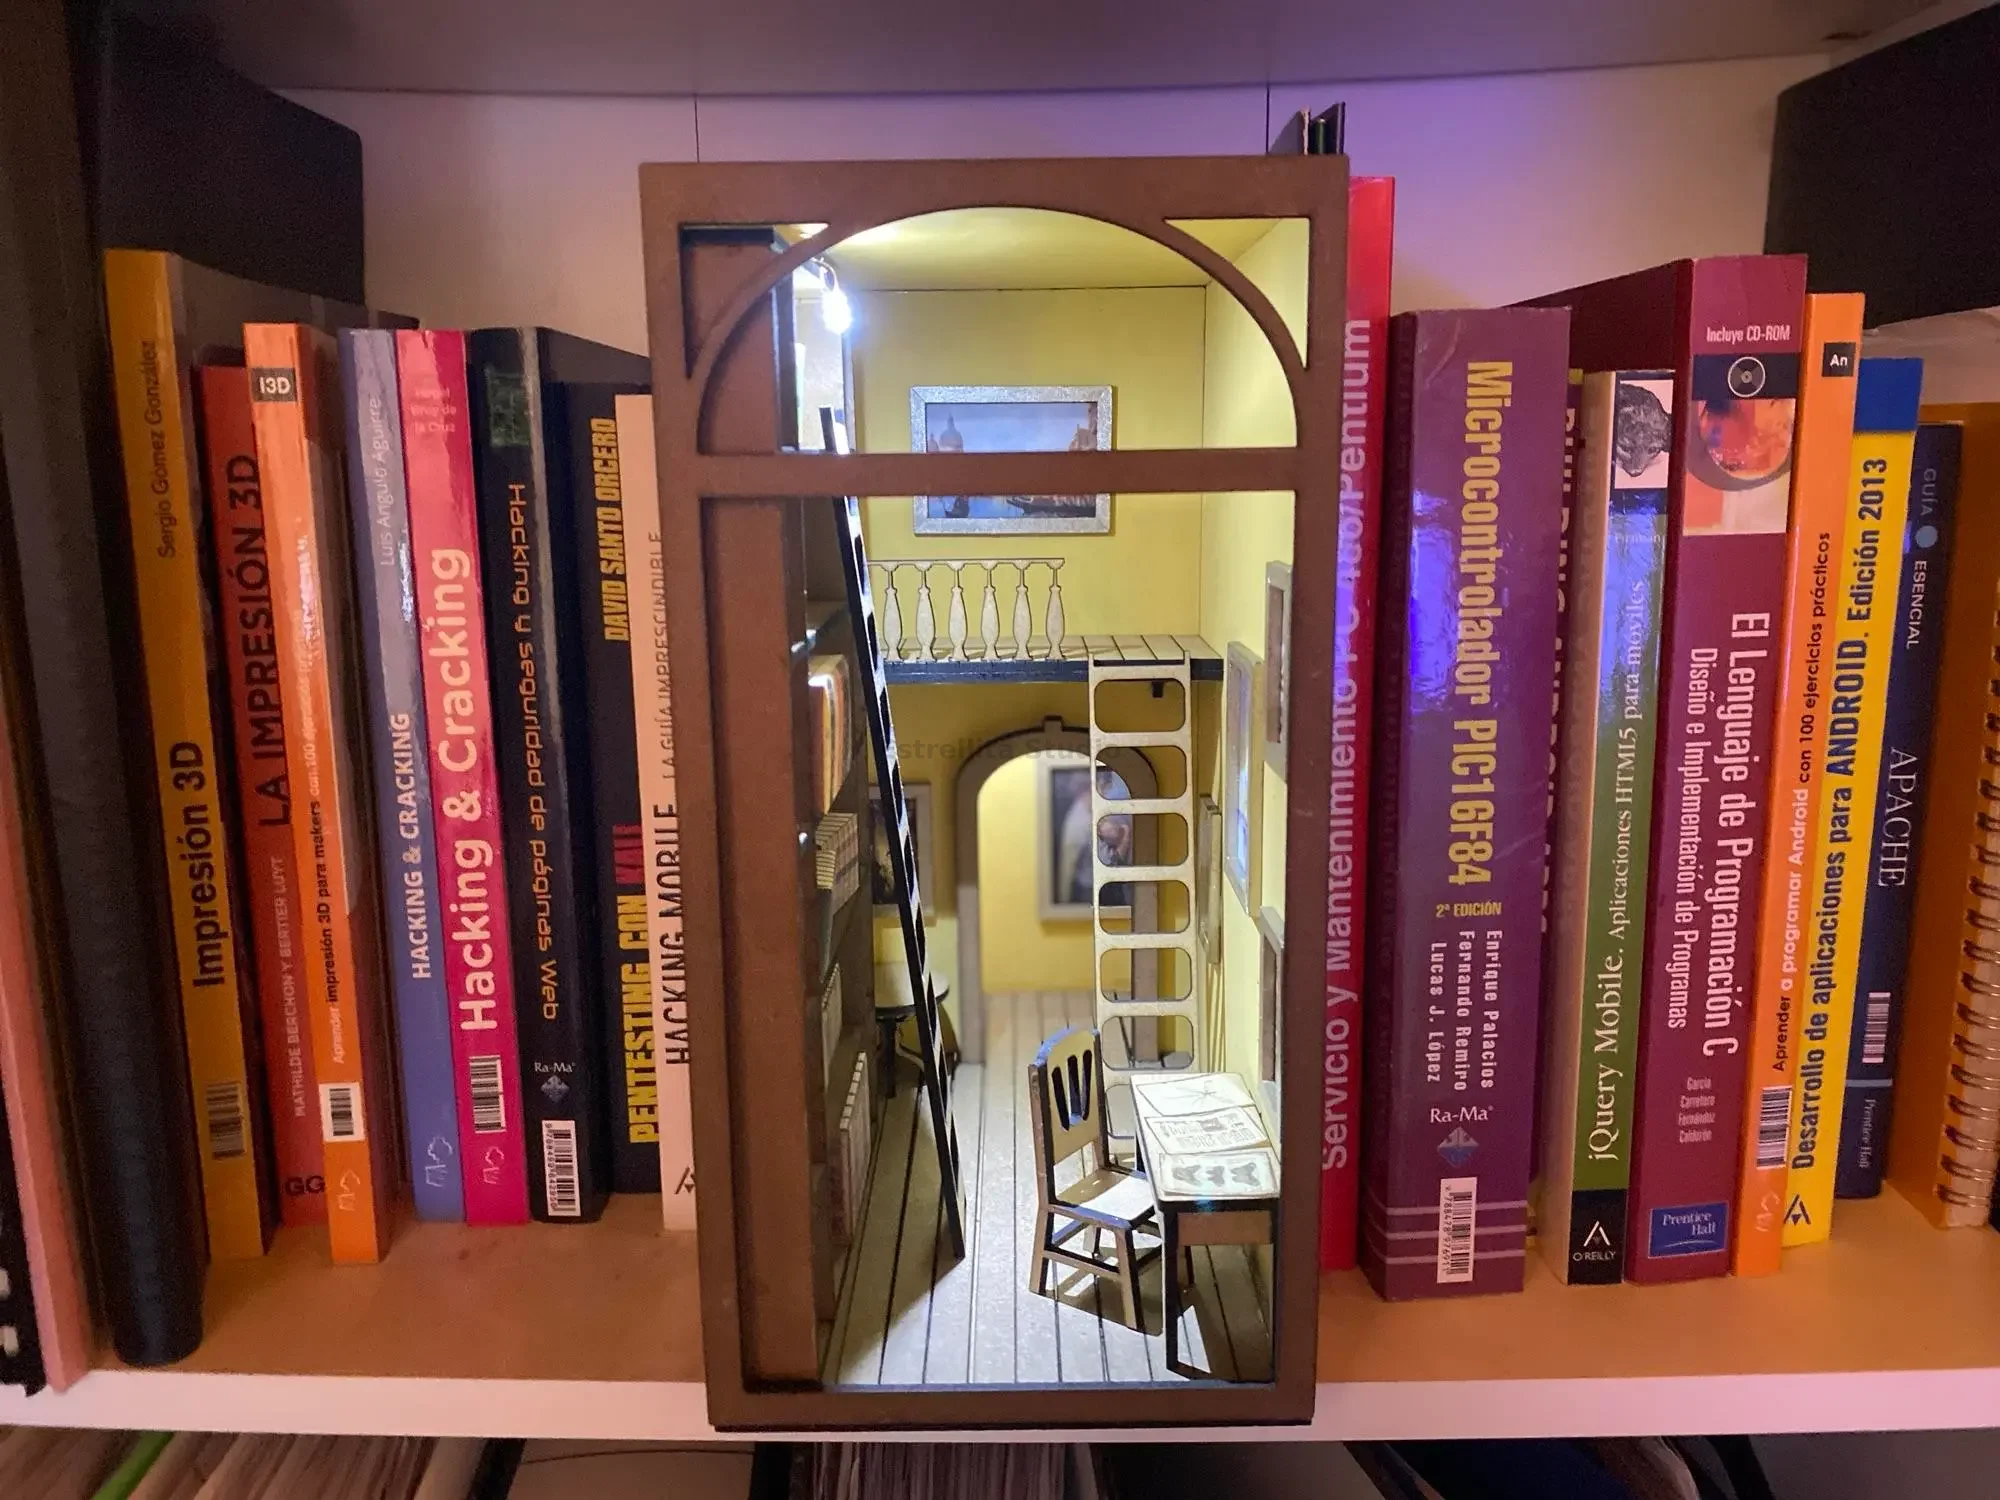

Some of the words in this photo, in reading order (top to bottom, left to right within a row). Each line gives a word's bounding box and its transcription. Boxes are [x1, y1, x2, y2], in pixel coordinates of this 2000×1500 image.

[1706, 328, 1744, 345] Incluye
[1746, 325, 1791, 342] CD-ROM
[1829, 353, 1848, 368] An
[259, 377, 290, 394] I3D
[368, 397, 390, 465] Aguirre
[591, 418, 620, 500] ORCERO
[226, 456, 258, 509] 3D
[378, 467, 396, 529] Angulo
[1858, 459, 1887, 521] 2013
[1920, 468, 1936, 516] GUÍA
[158, 497, 179, 560] Sergio
[381, 531, 394, 566] Luis
[508, 485, 531, 605] Hacking
[600, 507, 625, 575] SANTO
[1455, 361, 1514, 704] Microcontrolador
[1814, 532, 1831, 618] prácticos
[1847, 529, 1880, 622] Edición
[1906, 560, 1928, 650] ESENCIAL
[227, 527, 287, 757] IMPRESIÓN
[514, 614, 532, 632] y
[604, 580, 629, 642] DAVID
[1625, 581, 1645, 665] móviles
[1731, 612, 1770, 638] El
[426, 548, 478, 773] Cracking
[1686, 648, 1718, 717] Diseño
[1810, 625, 1824, 709] ejercicios
[518, 640, 546, 789] seguridad
[1624, 673, 1643, 720] para
[1686, 721, 1704, 735] e
[1714, 649, 1768, 782] Lenguaje
[1801, 714, 1815, 745] 100
[1826, 632, 1869, 777] ANDROID.
[170, 741, 204, 792] 3D
[303, 743, 318, 769] 100
[389, 712, 420, 840] CRACKING
[1614, 726, 1638, 803] HTML5
[1800, 749, 1812, 783] con
[255, 774, 292, 826] LA
[309, 800, 326, 859] makers
[441, 789, 483, 823] &
[528, 804, 545, 832] de
[1326, 678, 1359, 971] Mantenimiento
[1448, 720, 1498, 886] PIC16F84
[1675, 740, 1711, 894] Implementación
[1717, 791, 1756, 827] de
[1790, 790, 1809, 866] Android
[1830, 788, 1853, 846] para
[1878, 746, 1919, 887] APACHE
[313, 864, 331, 898] para
[401, 845, 423, 864] &
[1607, 810, 1634, 940] Aplicaciones
[176, 803, 226, 987] Impresión
[316, 903, 331, 924] 3D
[407, 871, 432, 979] HACKING
[530, 838, 554, 952] páginas
[616, 895, 648, 949] CON
[1454, 900, 1502, 917] EDICIÓN
[1674, 900, 1700, 923] de
[1782, 872, 1804, 974] programar
[1813, 851, 1847, 1004] aplicaciones
[320, 928, 340, 1003] impresión
[451, 838, 497, 1031] Hacking
[1484, 930, 1503, 1002] Enrique
[1703, 836, 1754, 1031] Programación
[540, 958, 558, 1020] Web
[1325, 980, 1359, 1008] y
[1429, 941, 1448, 998] Lucas
[1457, 930, 1476, 1018] Fernando
[1594, 948, 1625, 1053] Mobile.
[1664, 929, 1700, 1029] Programas
[329, 1006, 345, 1064] Aprender
[1428, 1007, 1444, 1023] J.
[1702, 1038, 1739, 1057] C
[1773, 996, 1792, 1072] Aprender
[1805, 1008, 1830, 1040] de
[619, 963, 660, 1143] PENTESTING
[1426, 1028, 1445, 1083] López
[1454, 1026, 1473, 1092] Remiro
[1481, 1009, 1500, 1090] Palacios
[1322, 1017, 1349, 1170] Servicio
[1588, 1064, 1623, 1161] jQuery
[1793, 1049, 1825, 1170] Desarrollo
[286, 1175, 325, 1196] GG
[1663, 1213, 1712, 1226] Prentice
[1692, 1221, 1717, 1236] Hall
